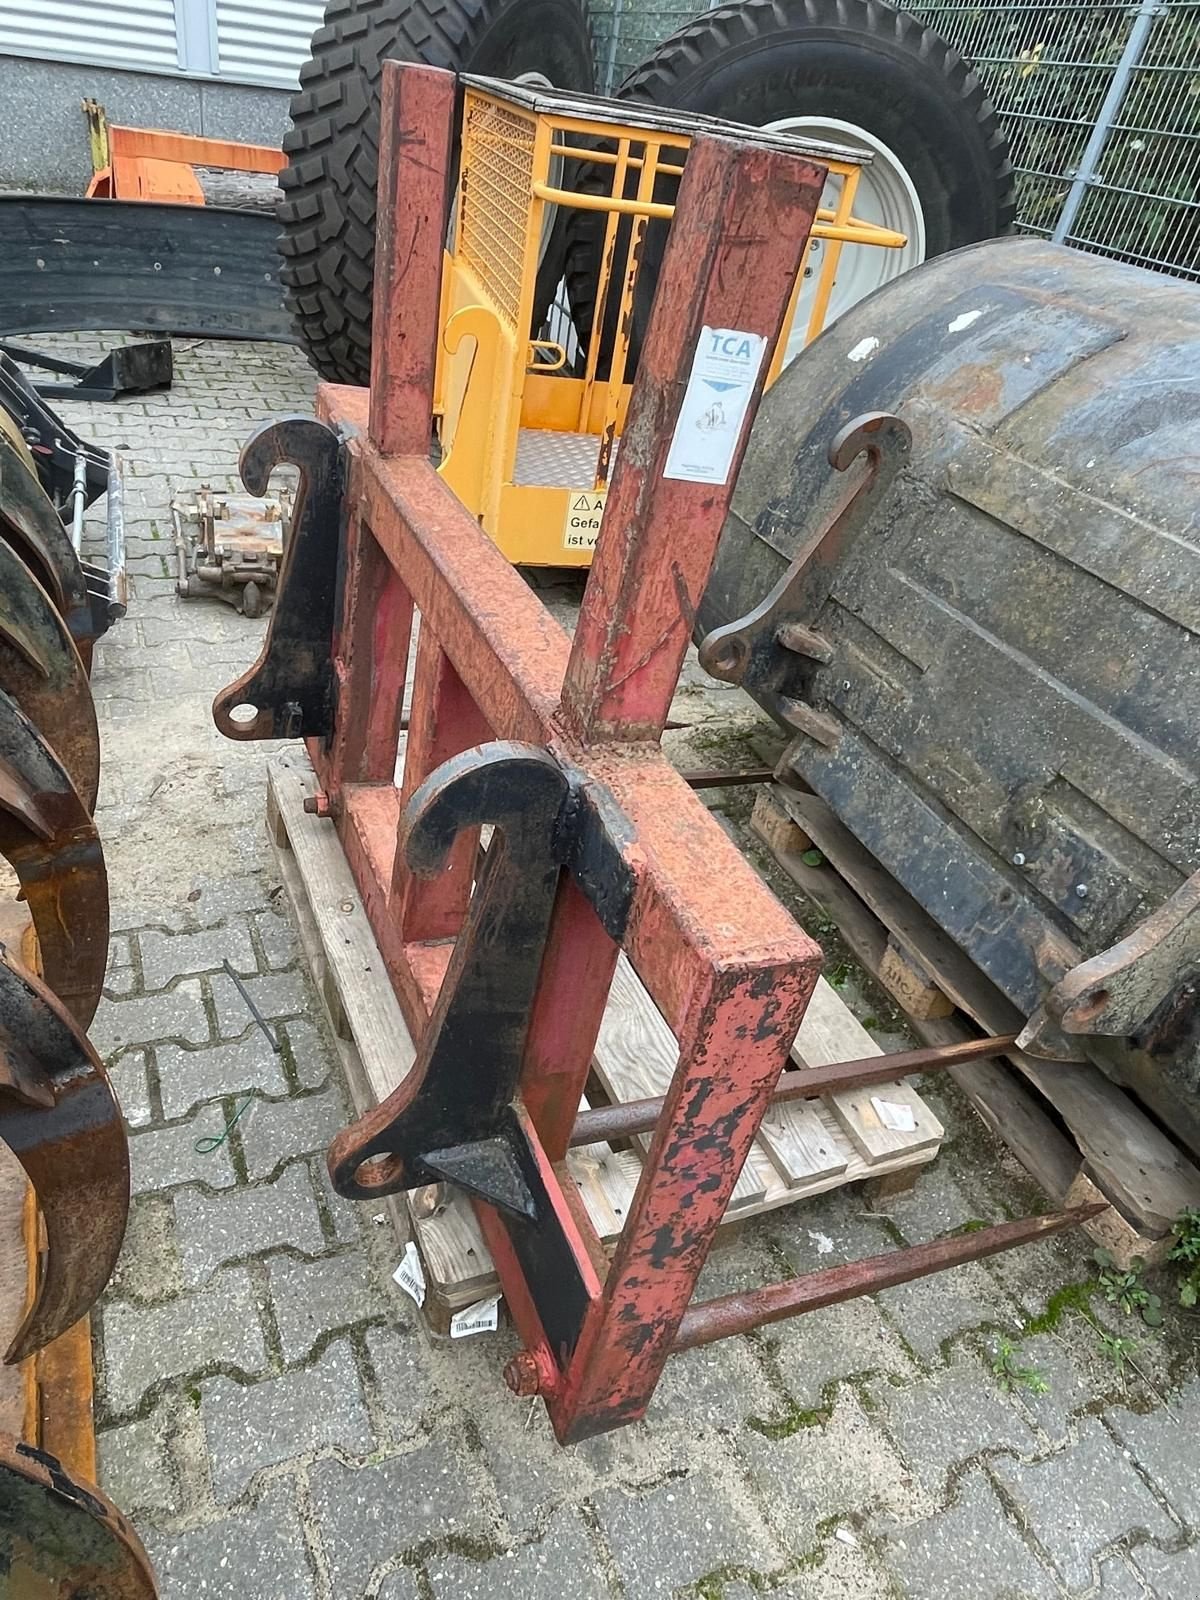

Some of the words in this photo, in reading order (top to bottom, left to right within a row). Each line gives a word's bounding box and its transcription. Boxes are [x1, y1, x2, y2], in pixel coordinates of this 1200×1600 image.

[711, 334, 751, 358] TCA
[570, 516, 600, 529] Gefa
[568, 534, 583, 545] ist
